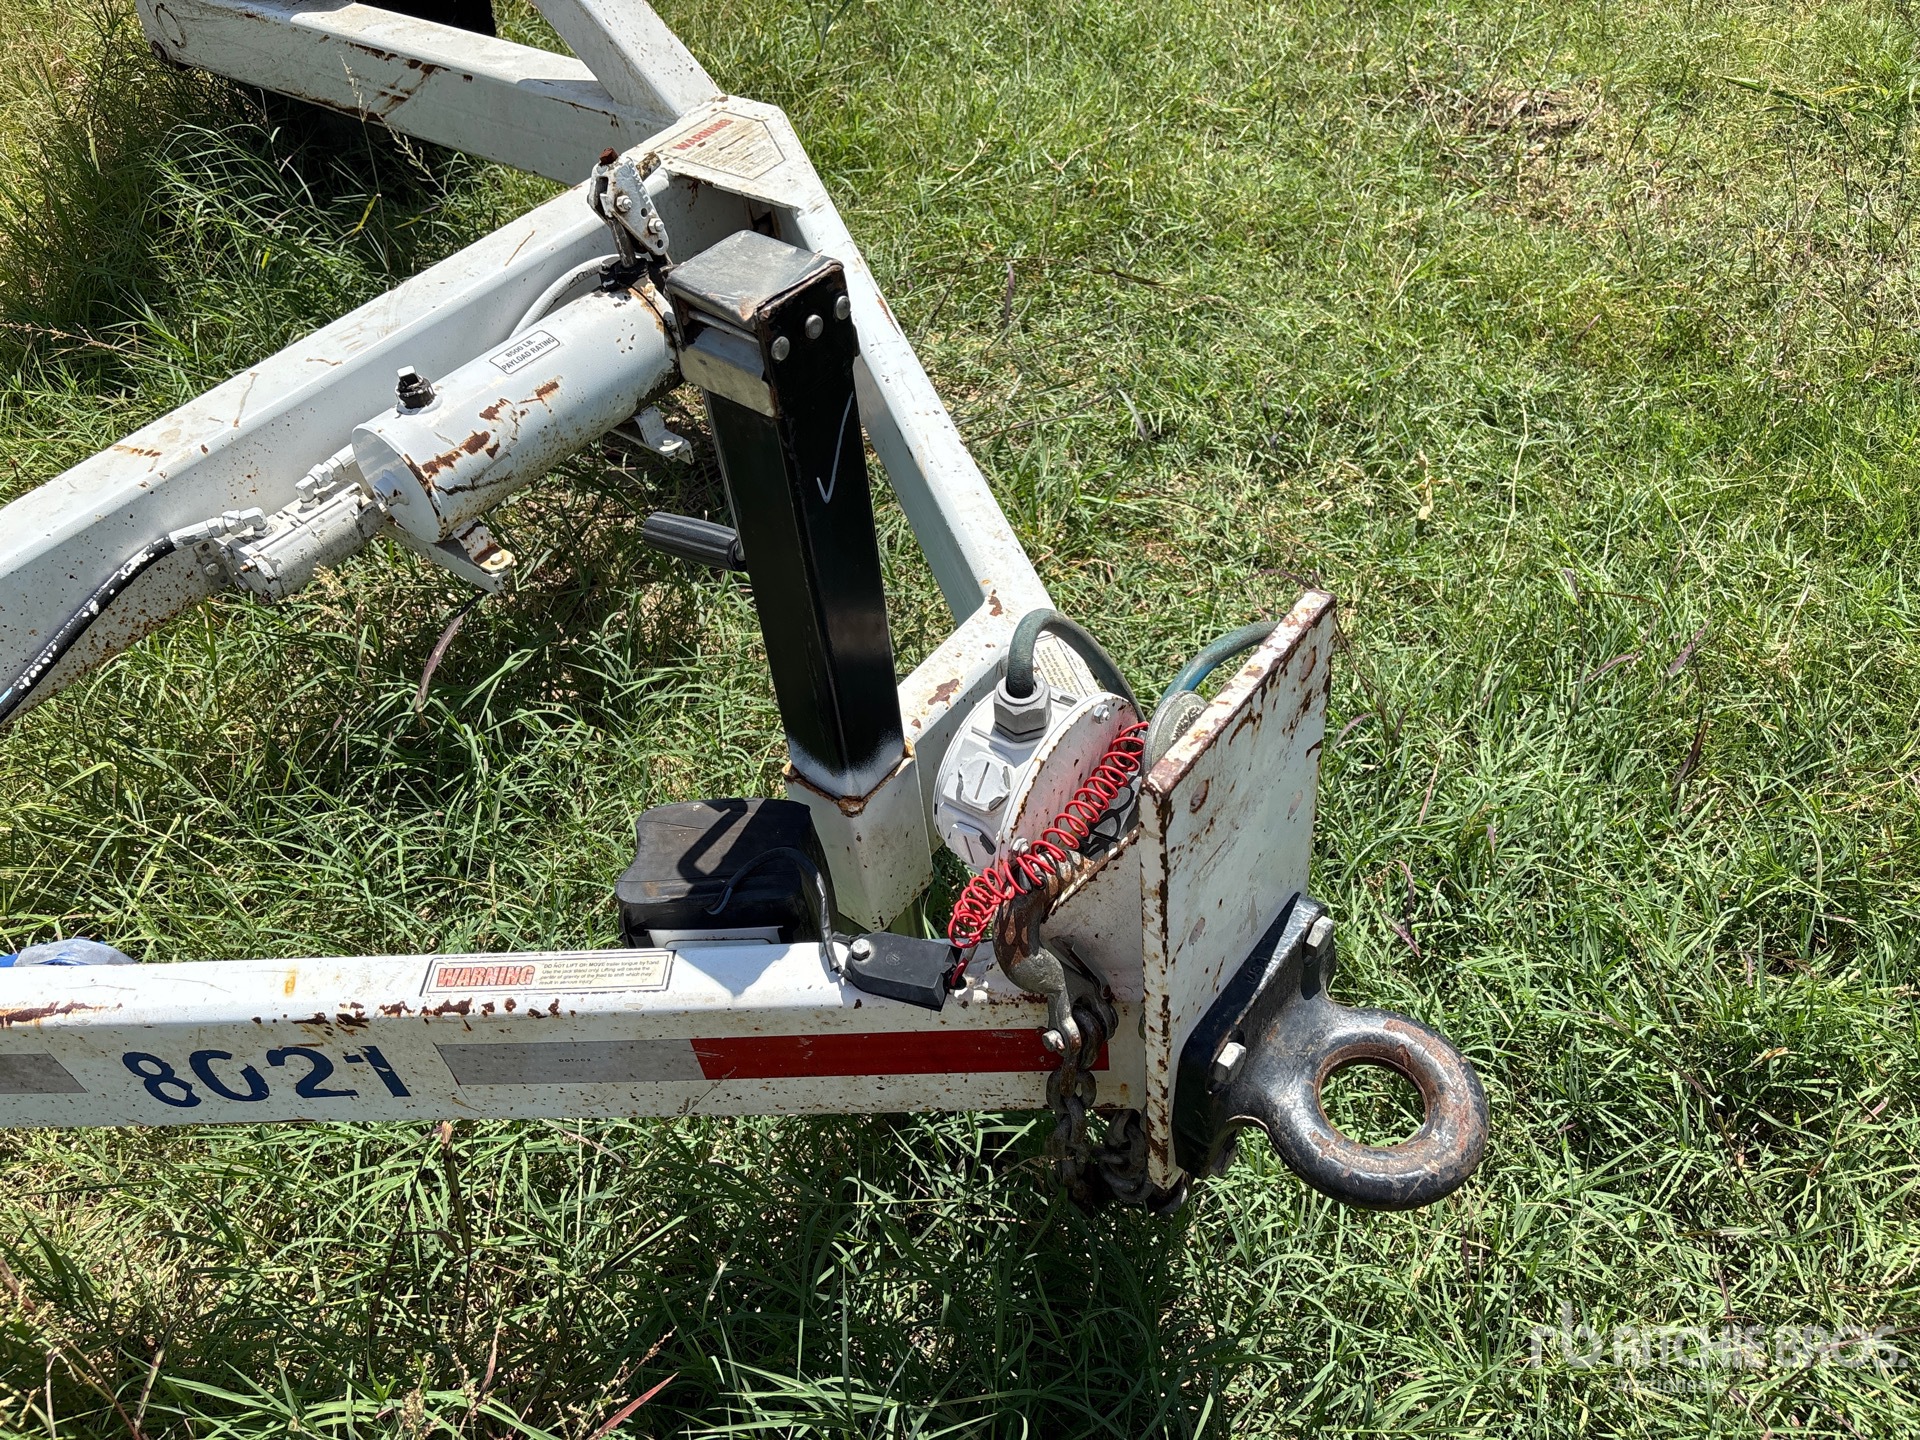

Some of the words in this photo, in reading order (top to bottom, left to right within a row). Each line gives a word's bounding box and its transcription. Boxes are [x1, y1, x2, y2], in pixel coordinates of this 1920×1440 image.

[672, 119, 734, 151] WARNING
[501, 350, 532, 371] PAYLOAD
[530, 337, 555, 354] RATING
[505, 345, 524, 358] 8500
[436, 965, 536, 988] WARNING
[122, 1045, 411, 1108] 8021
